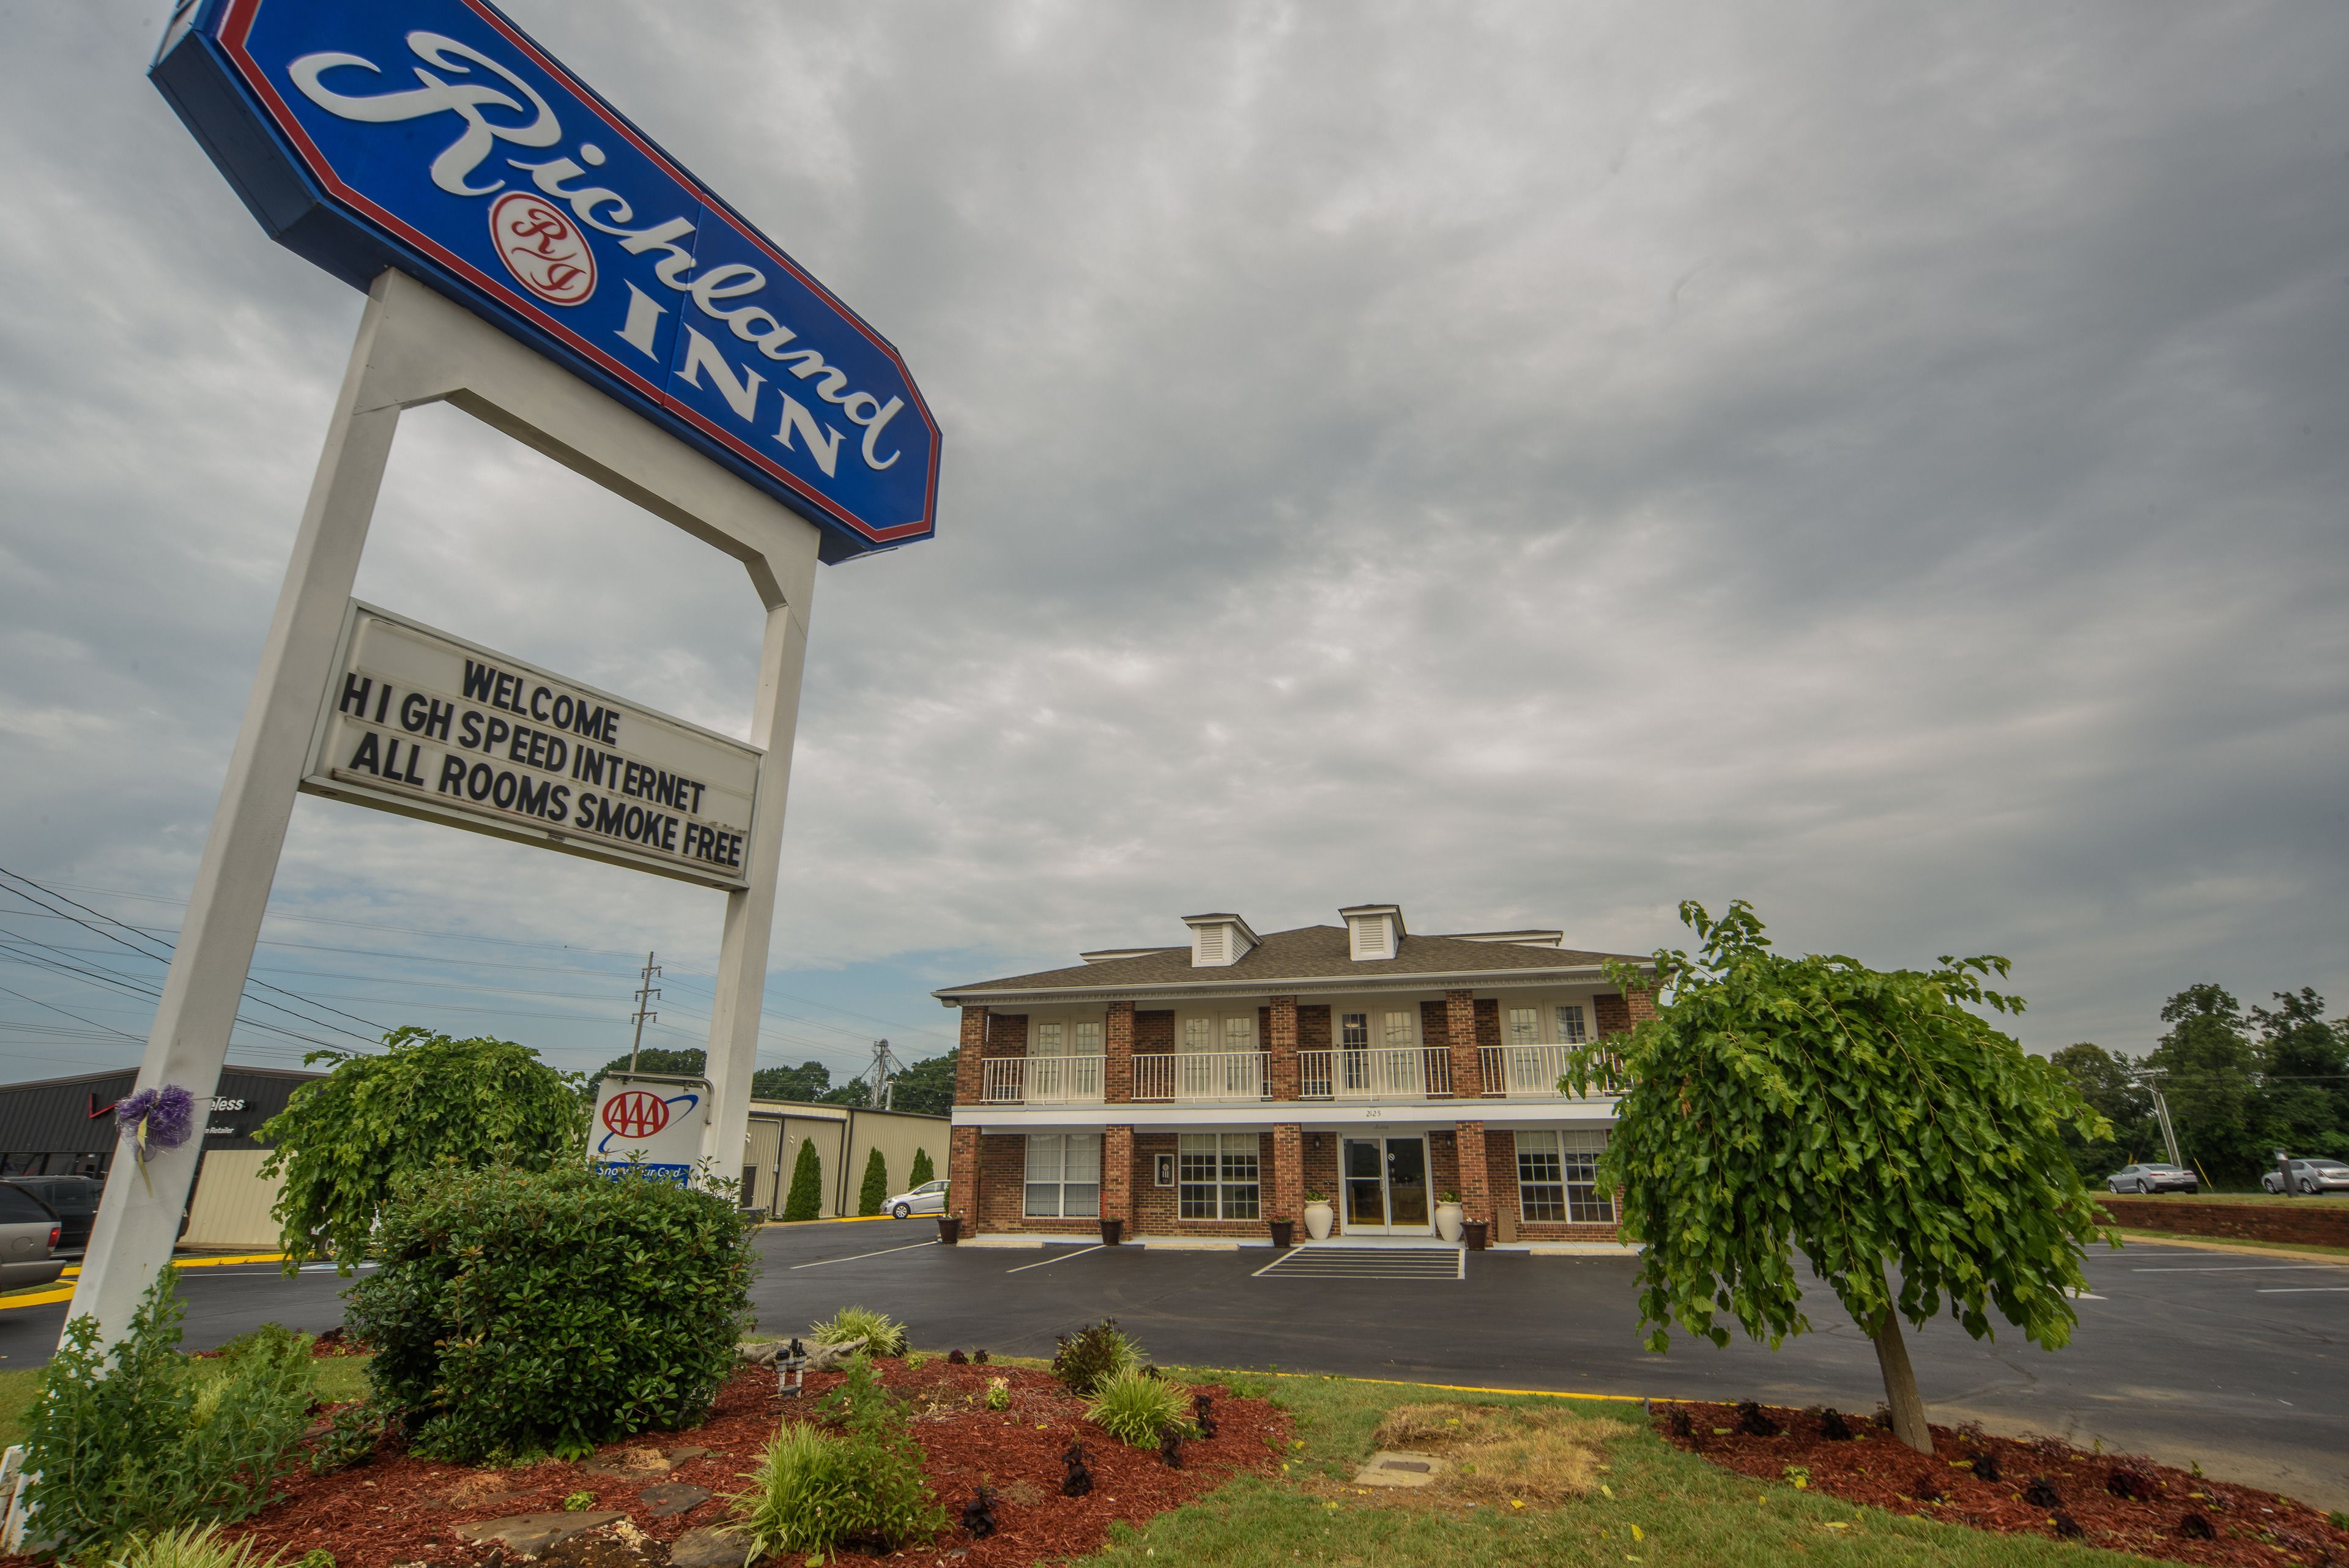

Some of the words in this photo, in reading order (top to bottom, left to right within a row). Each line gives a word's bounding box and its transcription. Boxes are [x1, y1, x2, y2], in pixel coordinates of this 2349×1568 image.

[288, 30, 905, 470] Richland
[613, 278, 847, 478] INN
[338, 671, 455, 741] HIGH
[458, 710, 568, 772] SPEED
[572, 744, 706, 814] INTERNET
[462, 659, 620, 744] WELCOME
[349, 732, 426, 787] ALL
[438, 753, 571, 822] ROOMS
[574, 792, 680, 851] SMOKE
[683, 823, 743, 868] FREE
[606, 1092, 664, 1137] AAA
[658, 1167, 681, 1178] Cad
